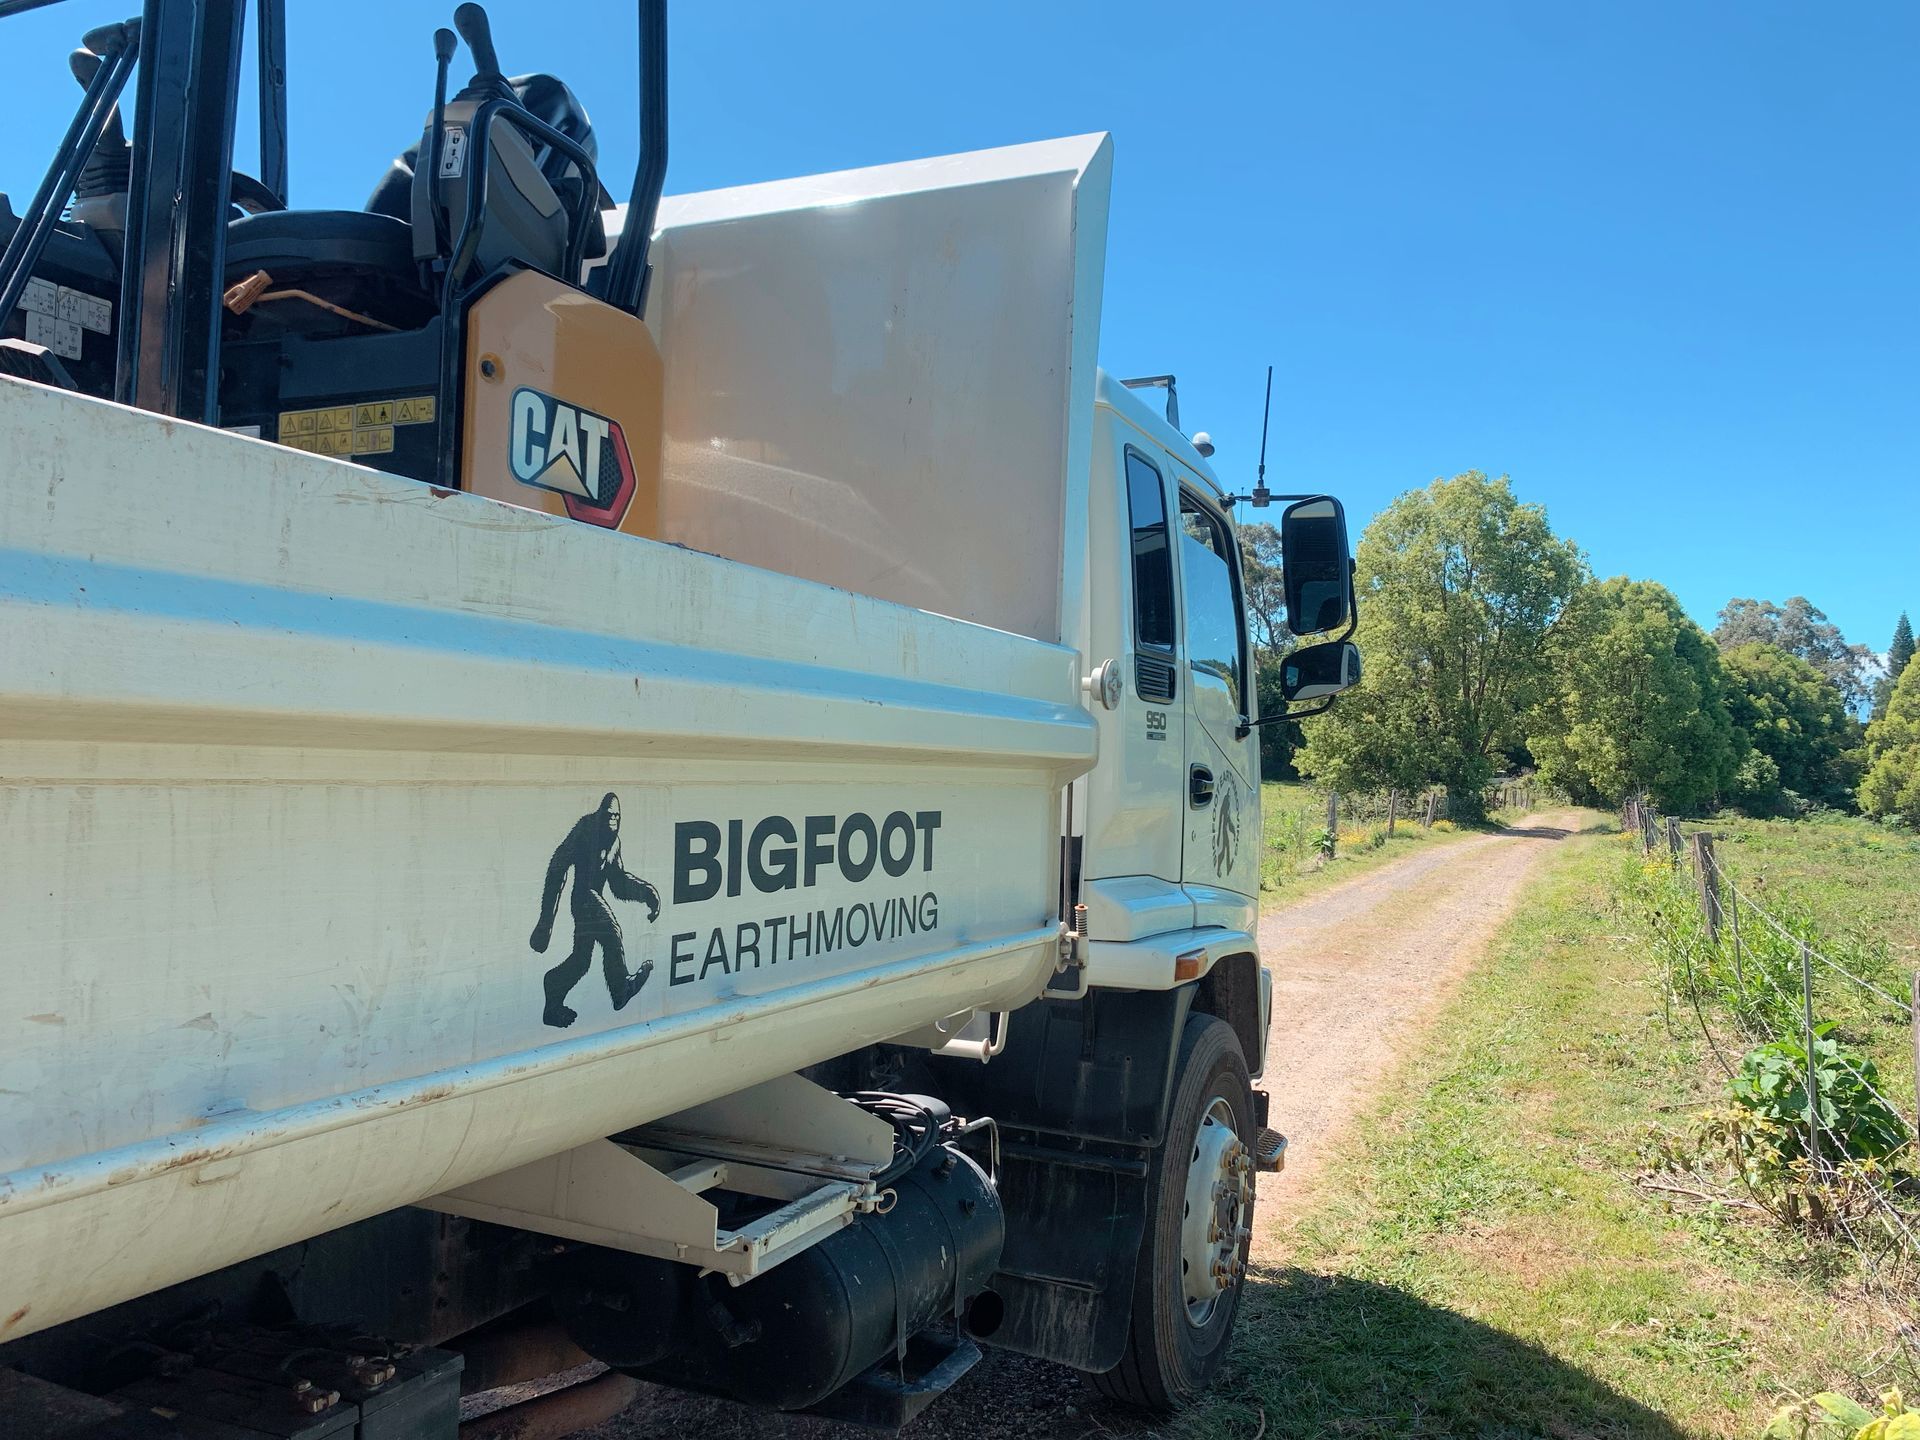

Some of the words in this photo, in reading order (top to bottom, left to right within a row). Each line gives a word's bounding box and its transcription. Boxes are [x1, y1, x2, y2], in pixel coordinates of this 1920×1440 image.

[512, 390, 609, 500] CAT
[1146, 710, 1167, 730] 950
[672, 810, 942, 905] BIGFOOT
[669, 891, 939, 987] EARTHMOVING
